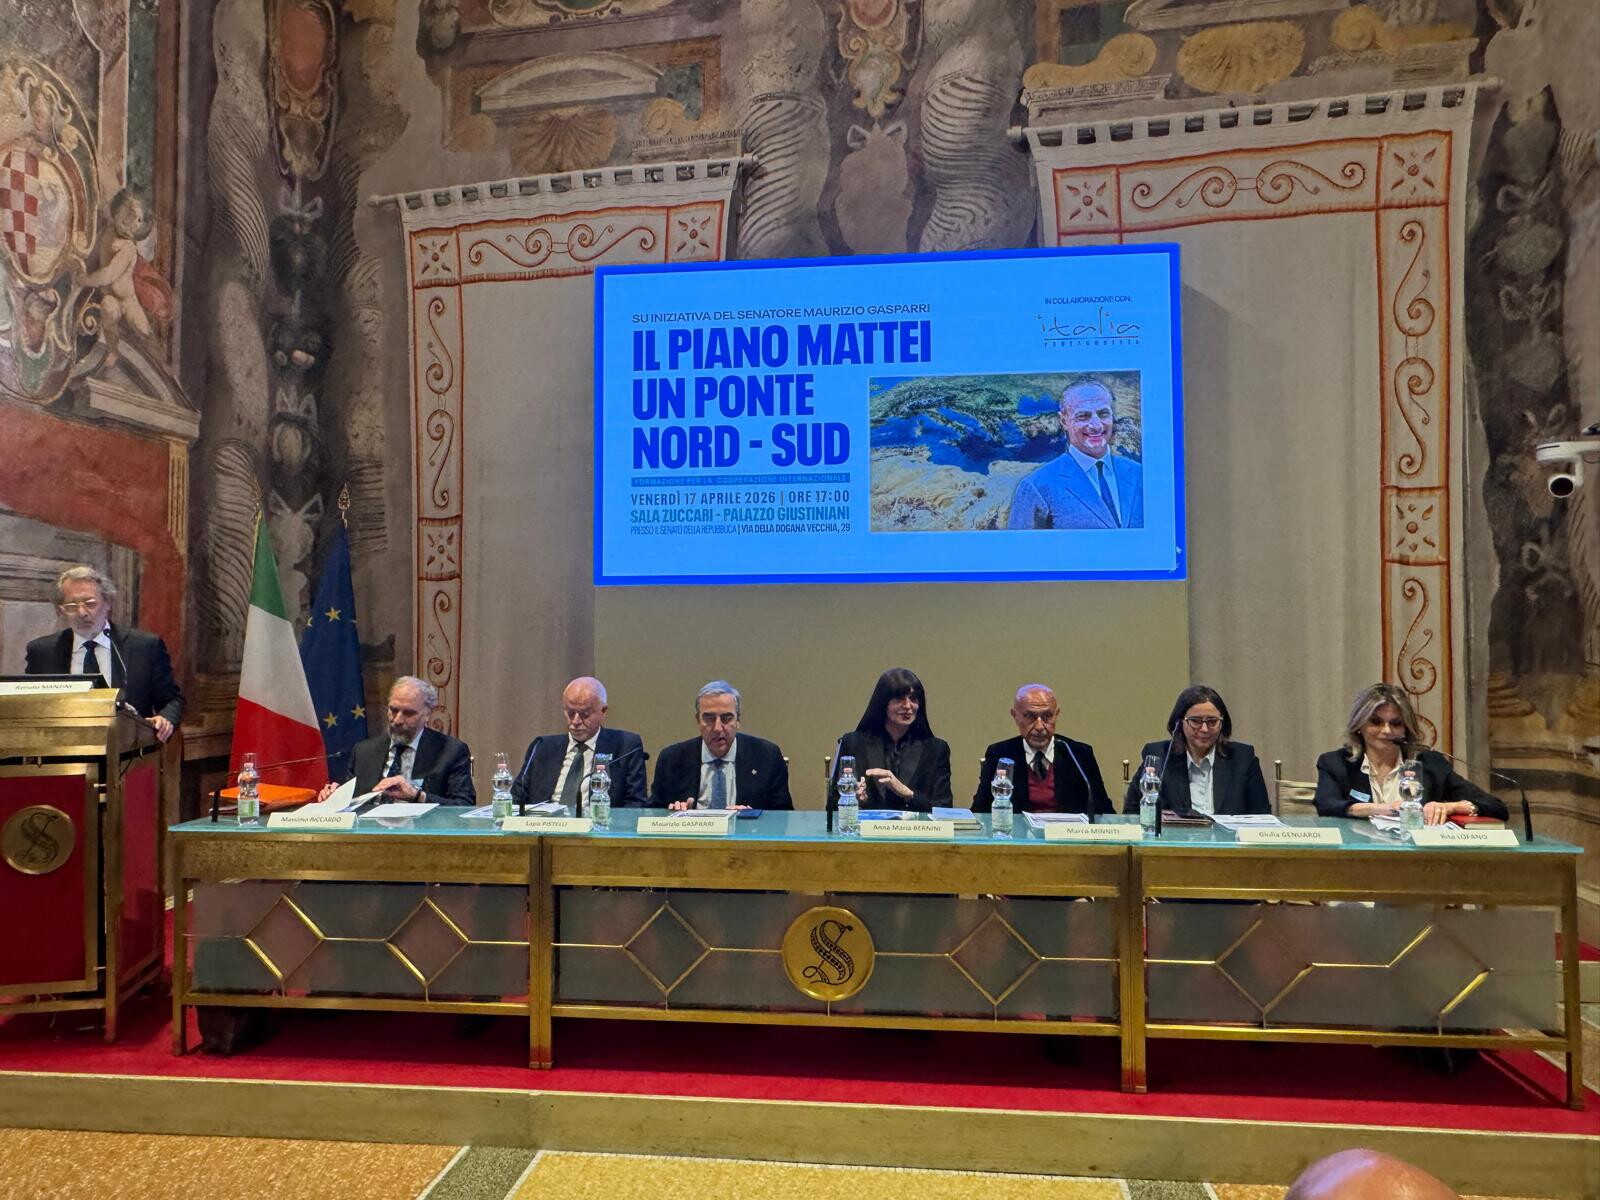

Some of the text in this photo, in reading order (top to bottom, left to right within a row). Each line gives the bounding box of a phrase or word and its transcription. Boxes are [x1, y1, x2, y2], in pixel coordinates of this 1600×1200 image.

[632, 304, 931, 323] SU INIZIATIVA DEL SENATORE MAURIZIO GASPARRI
[633, 320, 932, 371] IL PIANO MATTEI
[632, 373, 814, 420] UN PONTE
[632, 425, 740, 470] NORD
[771, 422, 850, 467] SUD
[631, 490, 680, 506] VENERDÌ
[685, 492, 697, 505] 17
[700, 491, 742, 505] APRILE
[744, 491, 776, 504] 2026
[788, 490, 812, 503] ORE
[815, 489, 850, 503] 17:00
[630, 509, 661, 523] SALA
[662, 508, 713, 522] ZUCCARI
[723, 507, 775, 522] PALAZZO
[777, 505, 850, 521] GIUSTINIANI
[630, 525, 654, 535] PRESSO
[741, 523, 754, 533] VIA
[754, 523, 776, 533] DELLA
[776, 523, 806, 533] DOGANA
[806, 522, 840, 533] VECCHIA,
[841, 522, 851, 532] 29
[542, 820, 568, 828] PISTELLI
[1281, 831, 1321, 839] GENUARDI
